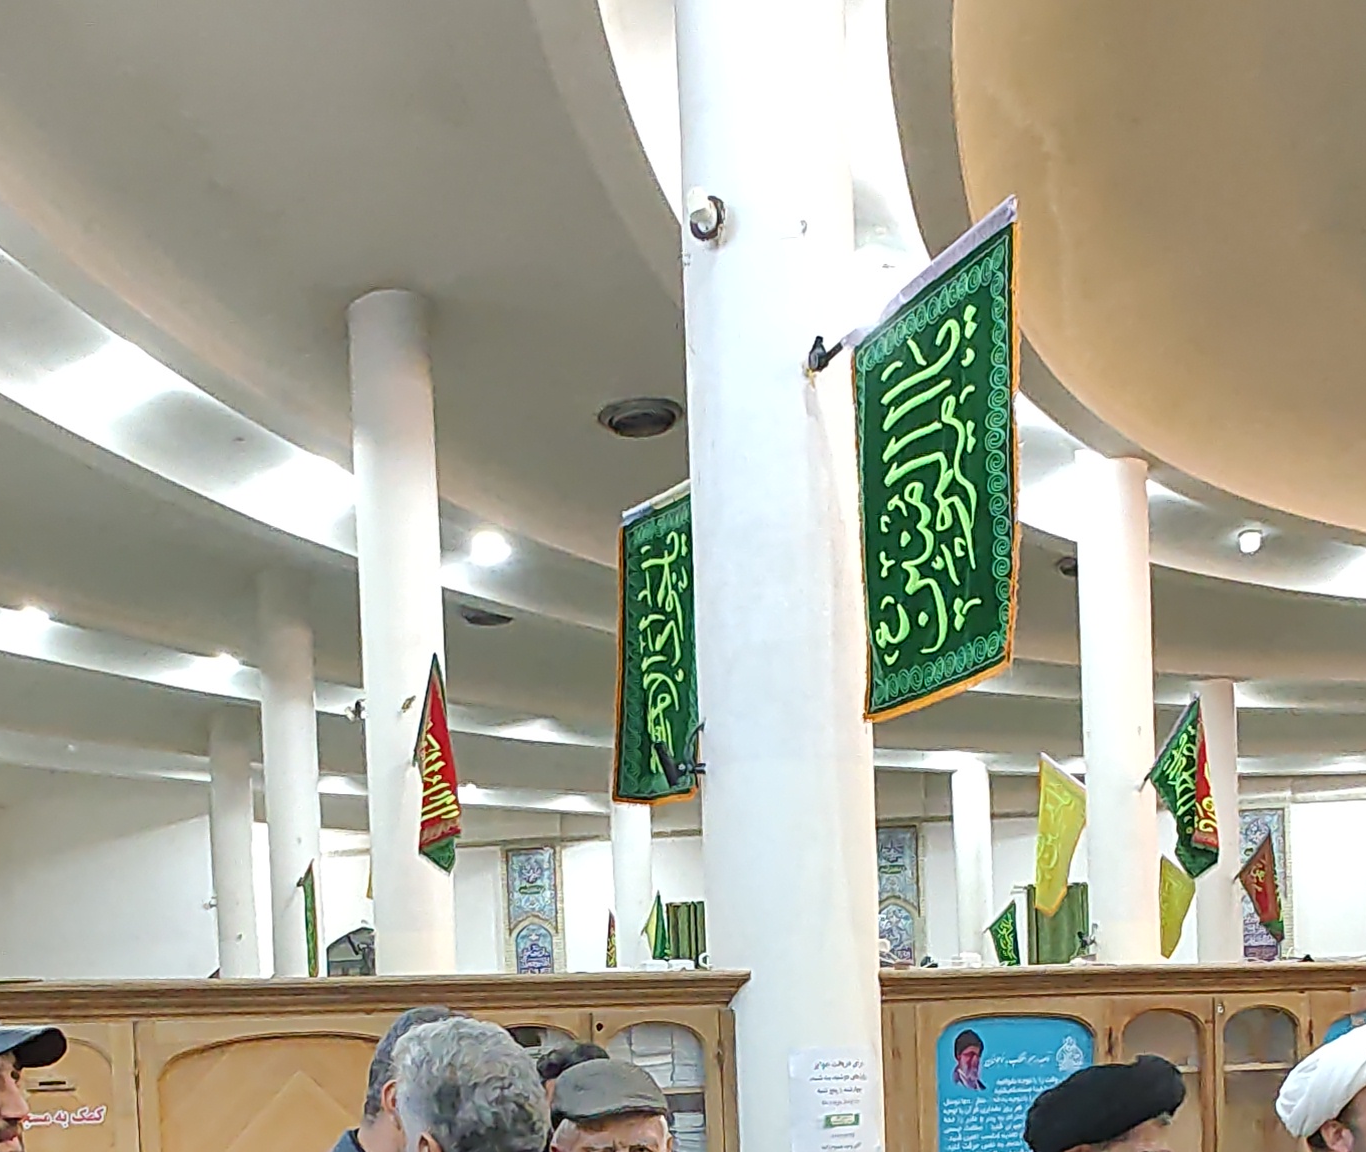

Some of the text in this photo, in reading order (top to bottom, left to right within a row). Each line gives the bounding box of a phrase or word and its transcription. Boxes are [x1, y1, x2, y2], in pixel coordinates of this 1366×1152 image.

[23, 1105, 107, 1130] کمک به مسج
